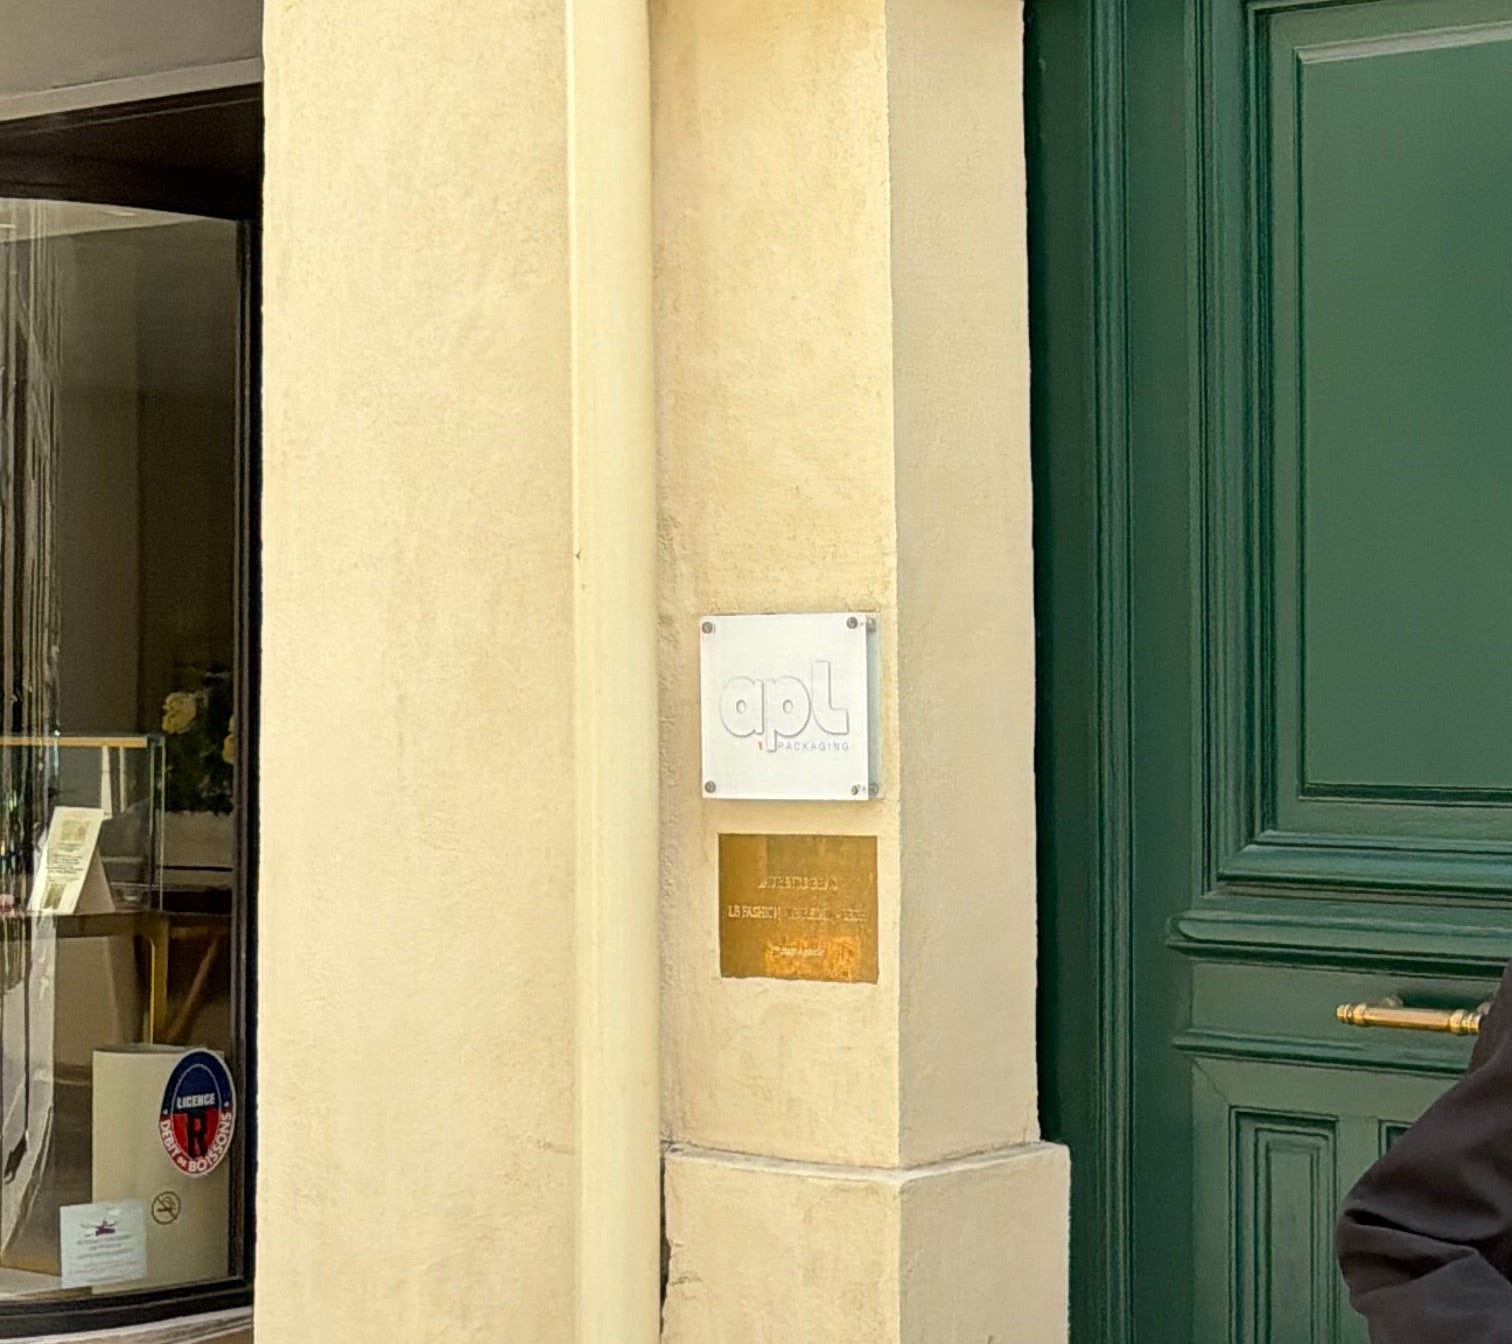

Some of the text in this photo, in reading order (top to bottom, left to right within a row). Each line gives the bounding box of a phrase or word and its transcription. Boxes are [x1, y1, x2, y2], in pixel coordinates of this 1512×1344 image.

[777, 741, 849, 752] PACKAGING
[176, 1093, 215, 1109] LICENCE
[188, 1111, 232, 1172] BOISSONS
